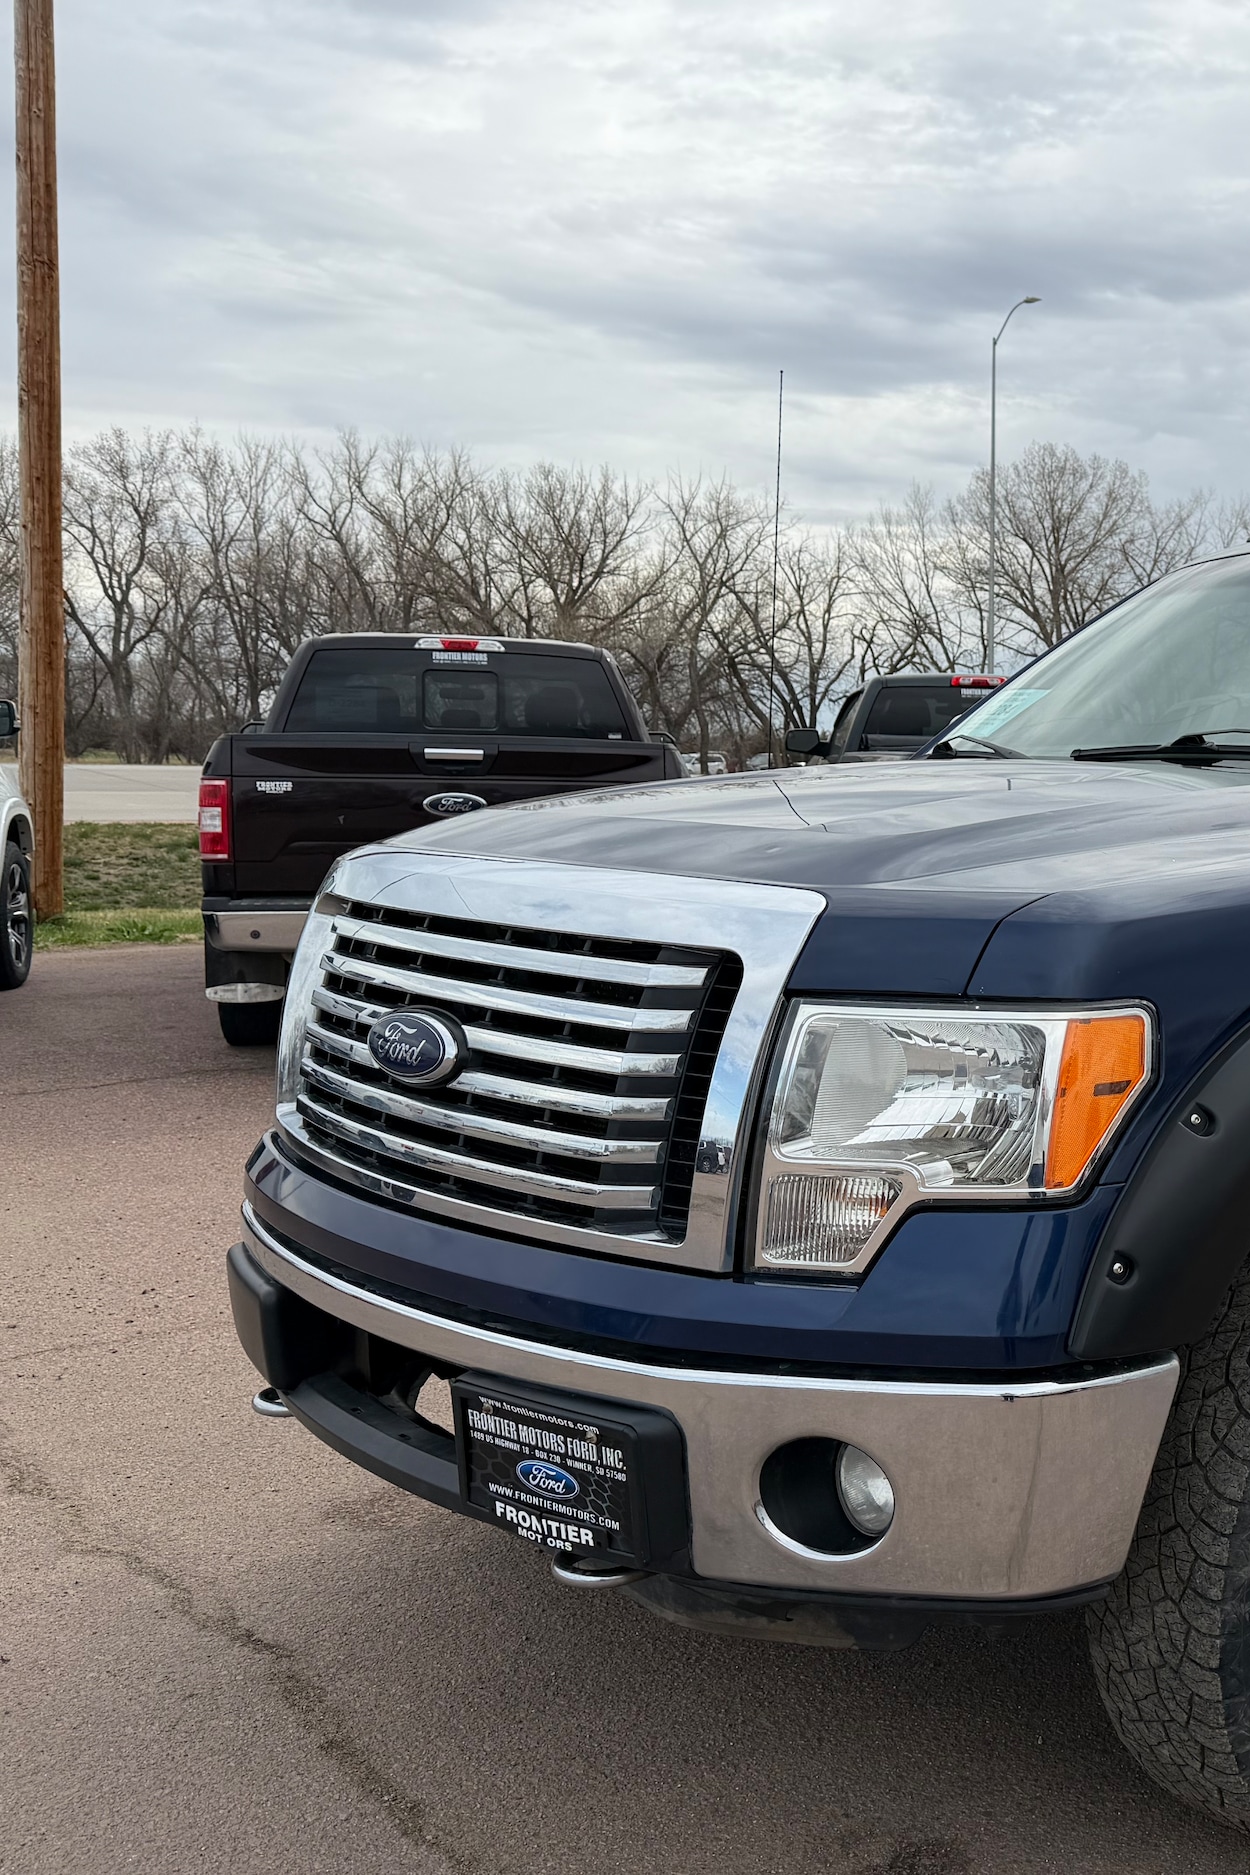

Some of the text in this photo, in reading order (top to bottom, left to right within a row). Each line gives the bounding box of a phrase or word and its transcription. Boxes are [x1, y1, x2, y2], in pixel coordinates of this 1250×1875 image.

[438, 797, 472, 811] Ford
[378, 1021, 427, 1067] Ford
[478, 1395, 600, 1435] www.frontiermotors.com
[467, 1408, 627, 1471] FRONTIER MOTORS FORD, INC.
[485, 1434, 494, 1444] US
[494, 1436, 521, 1453] HIGHWAY
[605, 1468, 627, 1482] 57580
[528, 1464, 566, 1494] Ford
[488, 1481, 620, 1531] WWW.FRONTIERMOTORS.COM
[494, 1500, 595, 1547] FRONTIER
